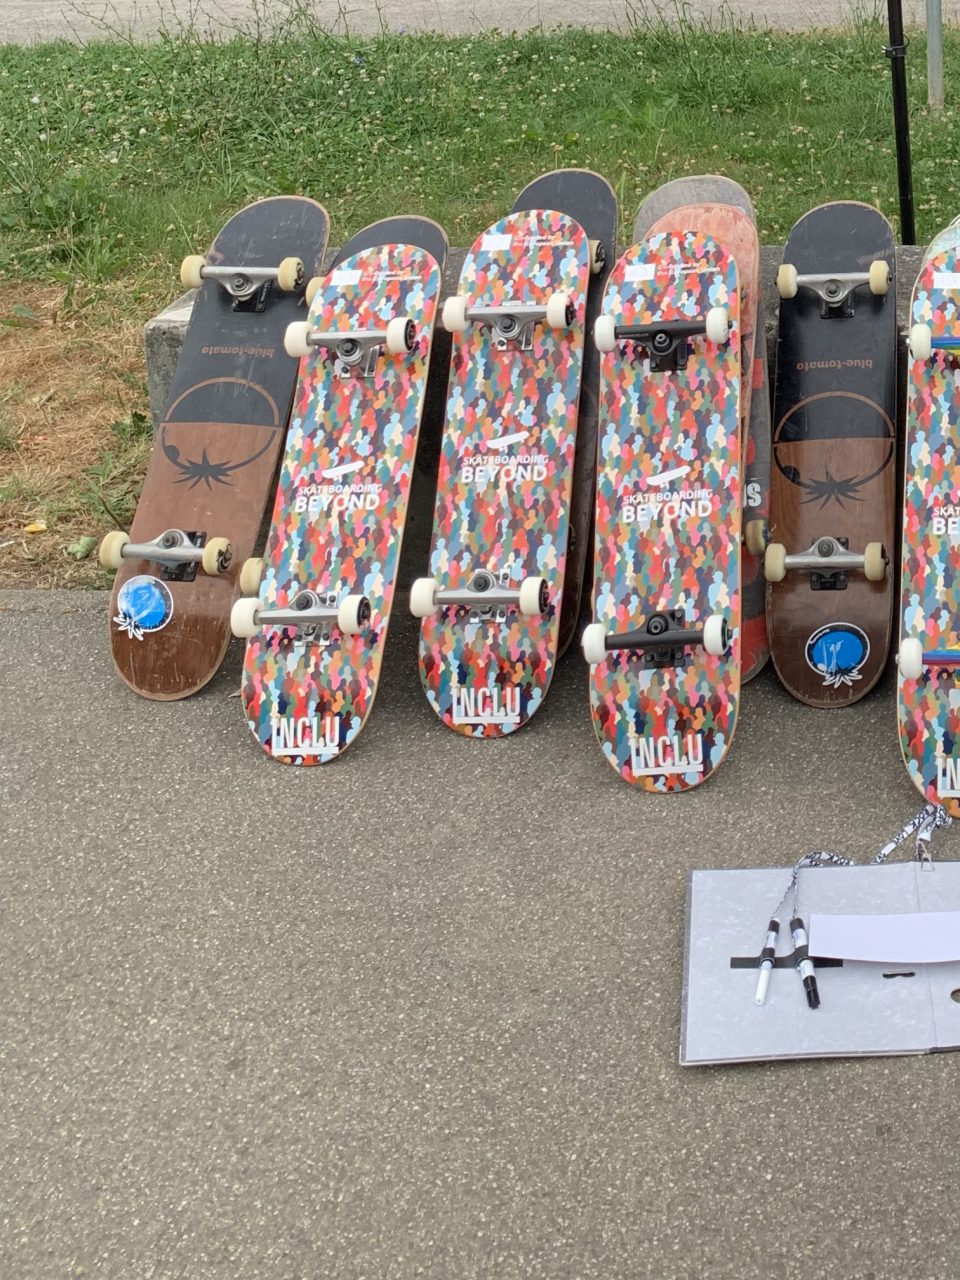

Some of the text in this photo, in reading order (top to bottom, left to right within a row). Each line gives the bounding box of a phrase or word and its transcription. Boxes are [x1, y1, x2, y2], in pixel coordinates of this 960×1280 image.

[202, 346, 275, 359] blue-tomato
[796, 358, 874, 371] blue-tomato
[463, 454, 549, 466] SKATEBOARDING
[461, 464, 548, 483] BEYOND
[298, 484, 382, 496] SKATEBOARDING
[623, 489, 713, 504] SKATEBOARDING
[294, 494, 380, 513] BEYOND
[622, 501, 713, 523] BEYOND
[452, 687, 521, 720] INCLU
[272, 716, 340, 752] INCLU
[629, 733, 704, 772] INCLU
